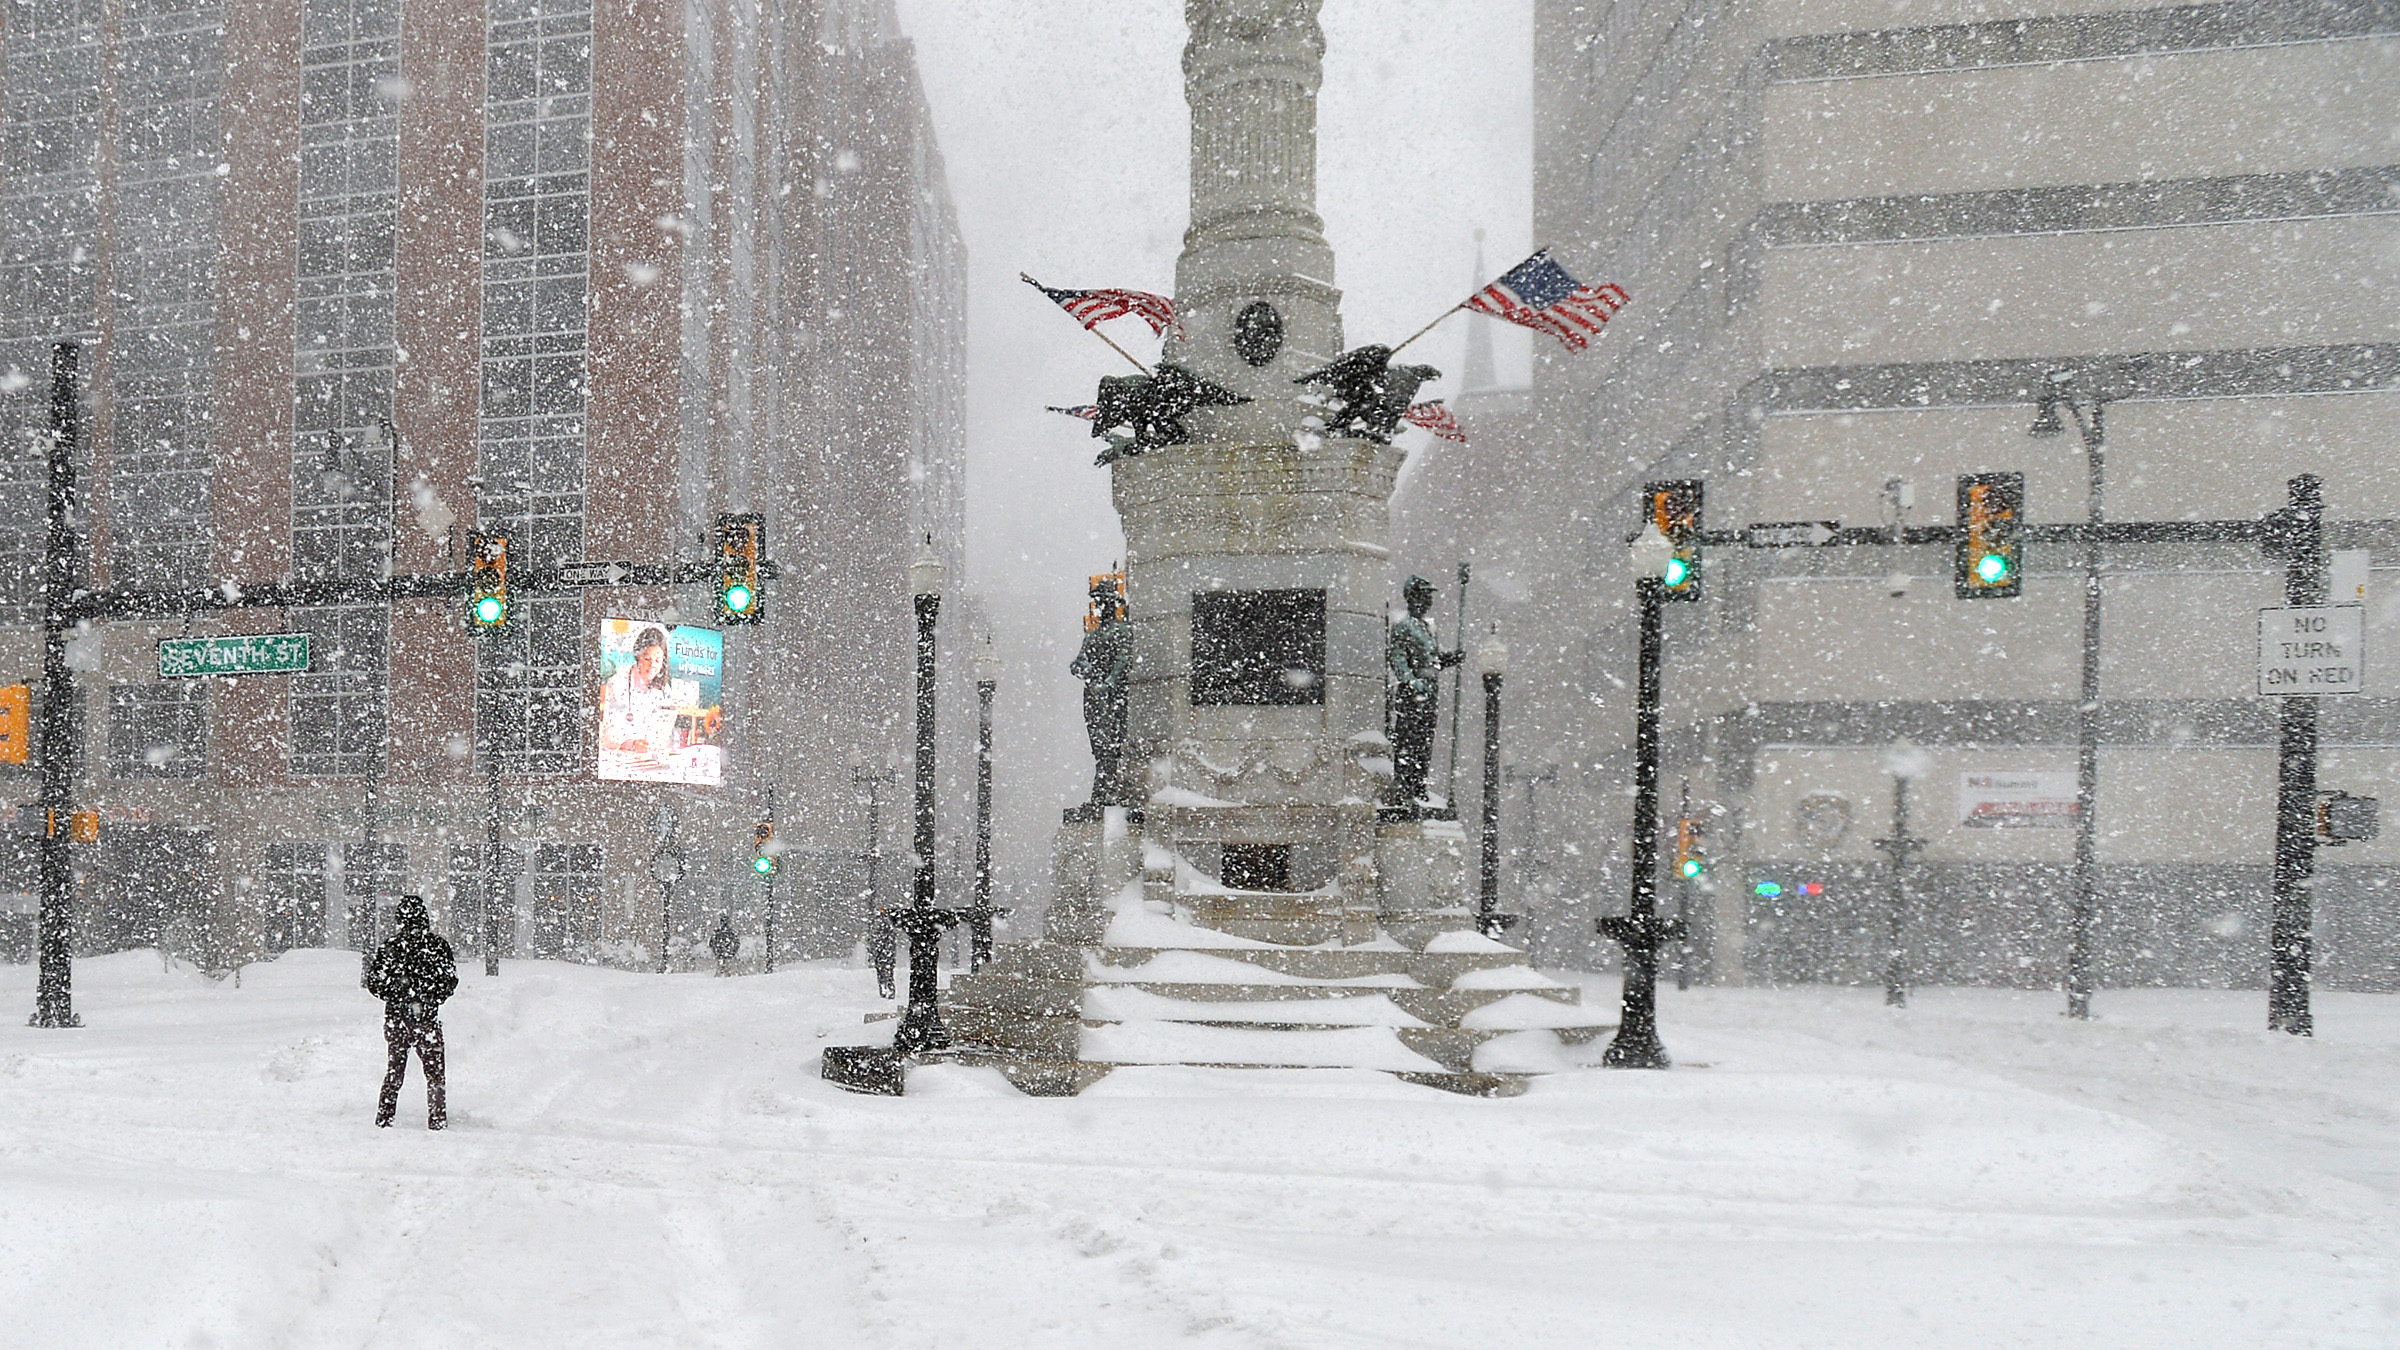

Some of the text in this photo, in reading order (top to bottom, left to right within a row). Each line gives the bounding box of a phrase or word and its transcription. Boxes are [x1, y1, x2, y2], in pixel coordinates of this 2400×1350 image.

[566, 569, 610, 579] ONE WAY
[2294, 616, 2326, 633] NO
[168, 644, 300, 667] SEVENTH ST
[675, 643, 703, 658] Funds
[2281, 642, 2340, 658] TURN
[2267, 667, 2354, 684] ON RED
